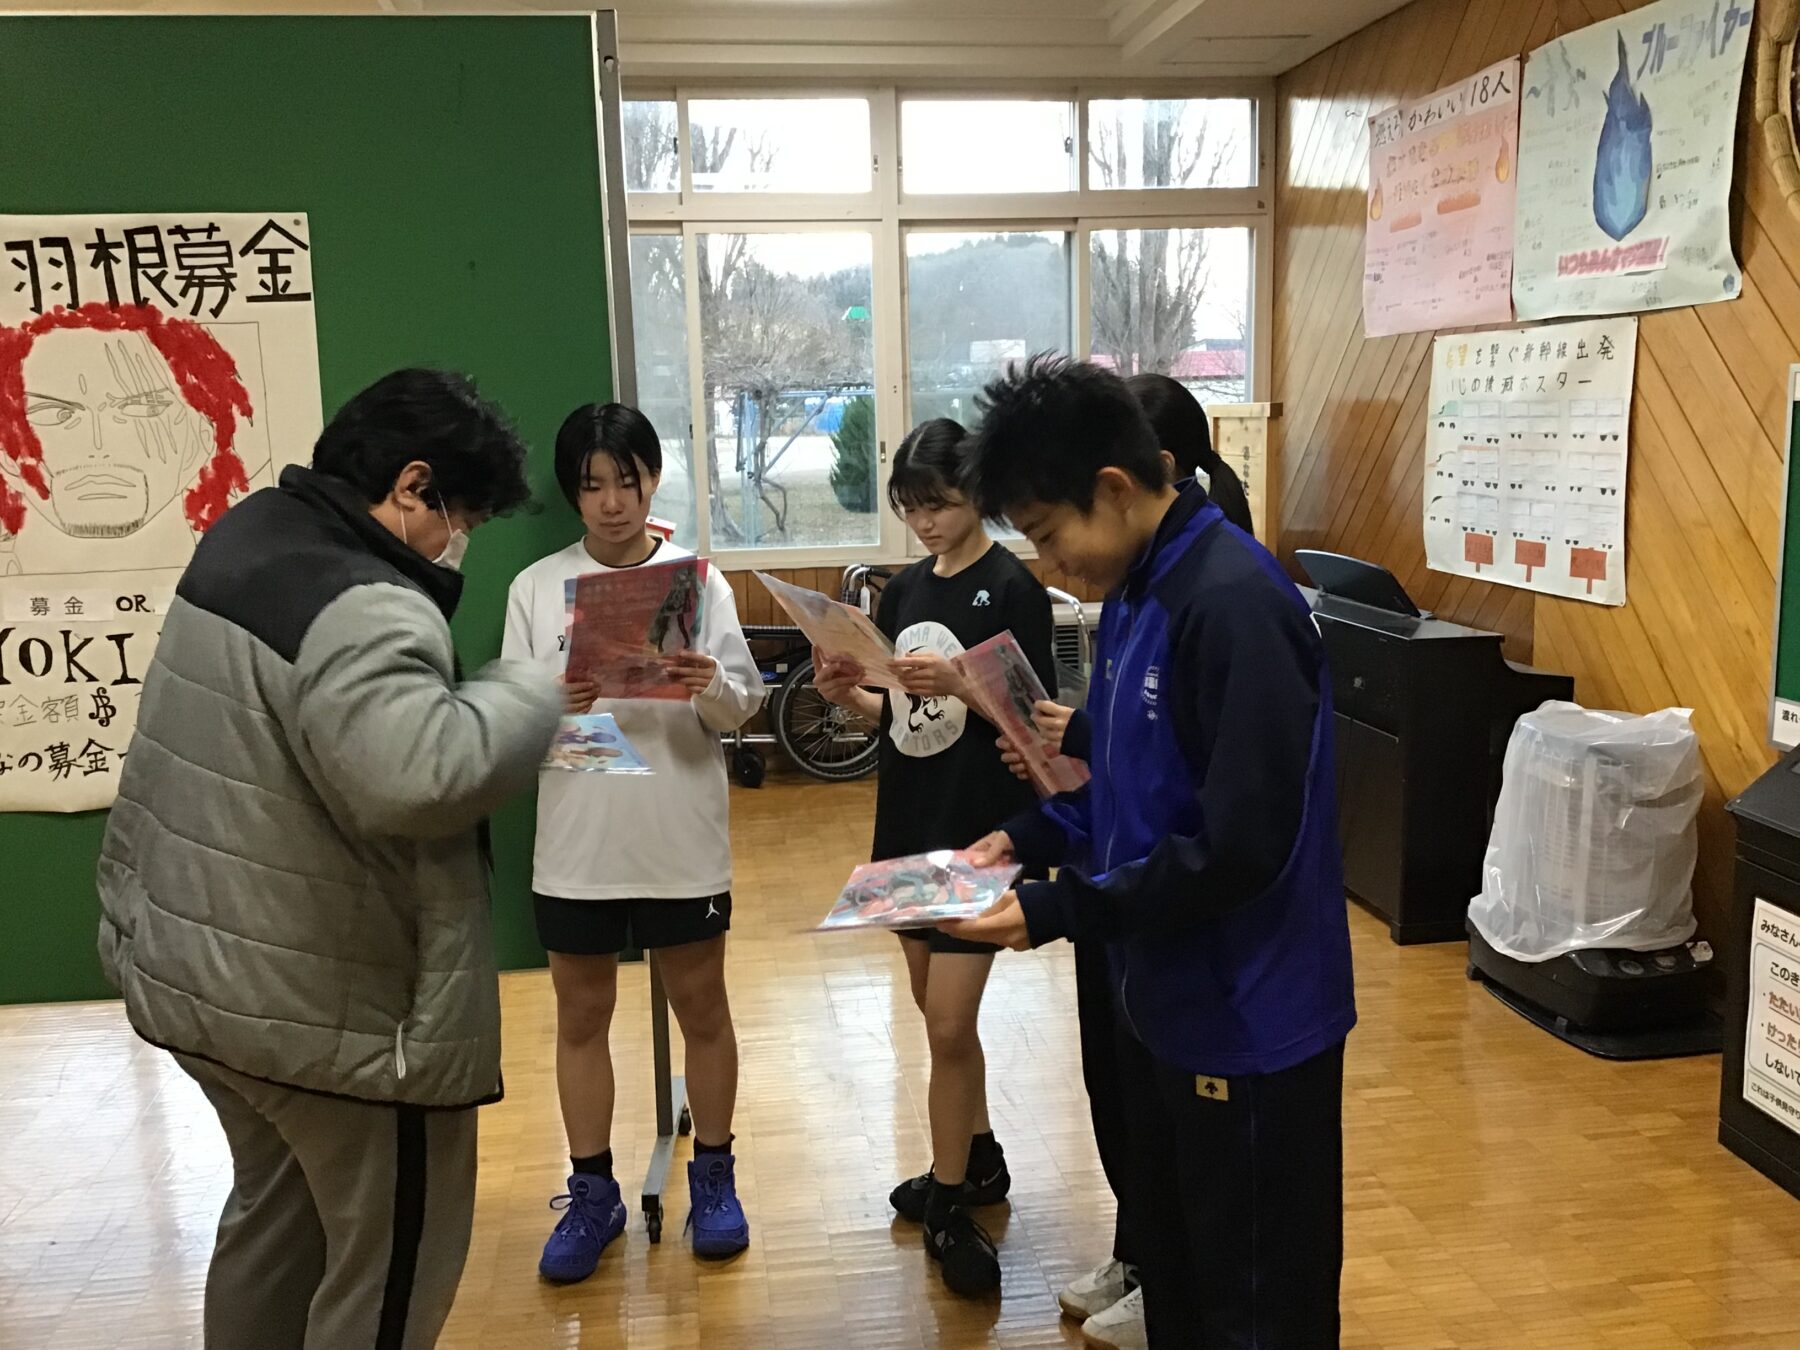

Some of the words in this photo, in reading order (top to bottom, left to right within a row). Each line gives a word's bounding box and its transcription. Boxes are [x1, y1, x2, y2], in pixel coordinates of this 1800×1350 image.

[1471, 70, 1511, 107] 18人
[4, 219, 312, 318] 羽根募金
[30, 596, 84, 616] 募金
[115, 595, 150, 613] OR
[0, 627, 162, 686] YOKI
[0, 694, 79, 727] 金額
[1760, 919, 1800, 948] みなさん
